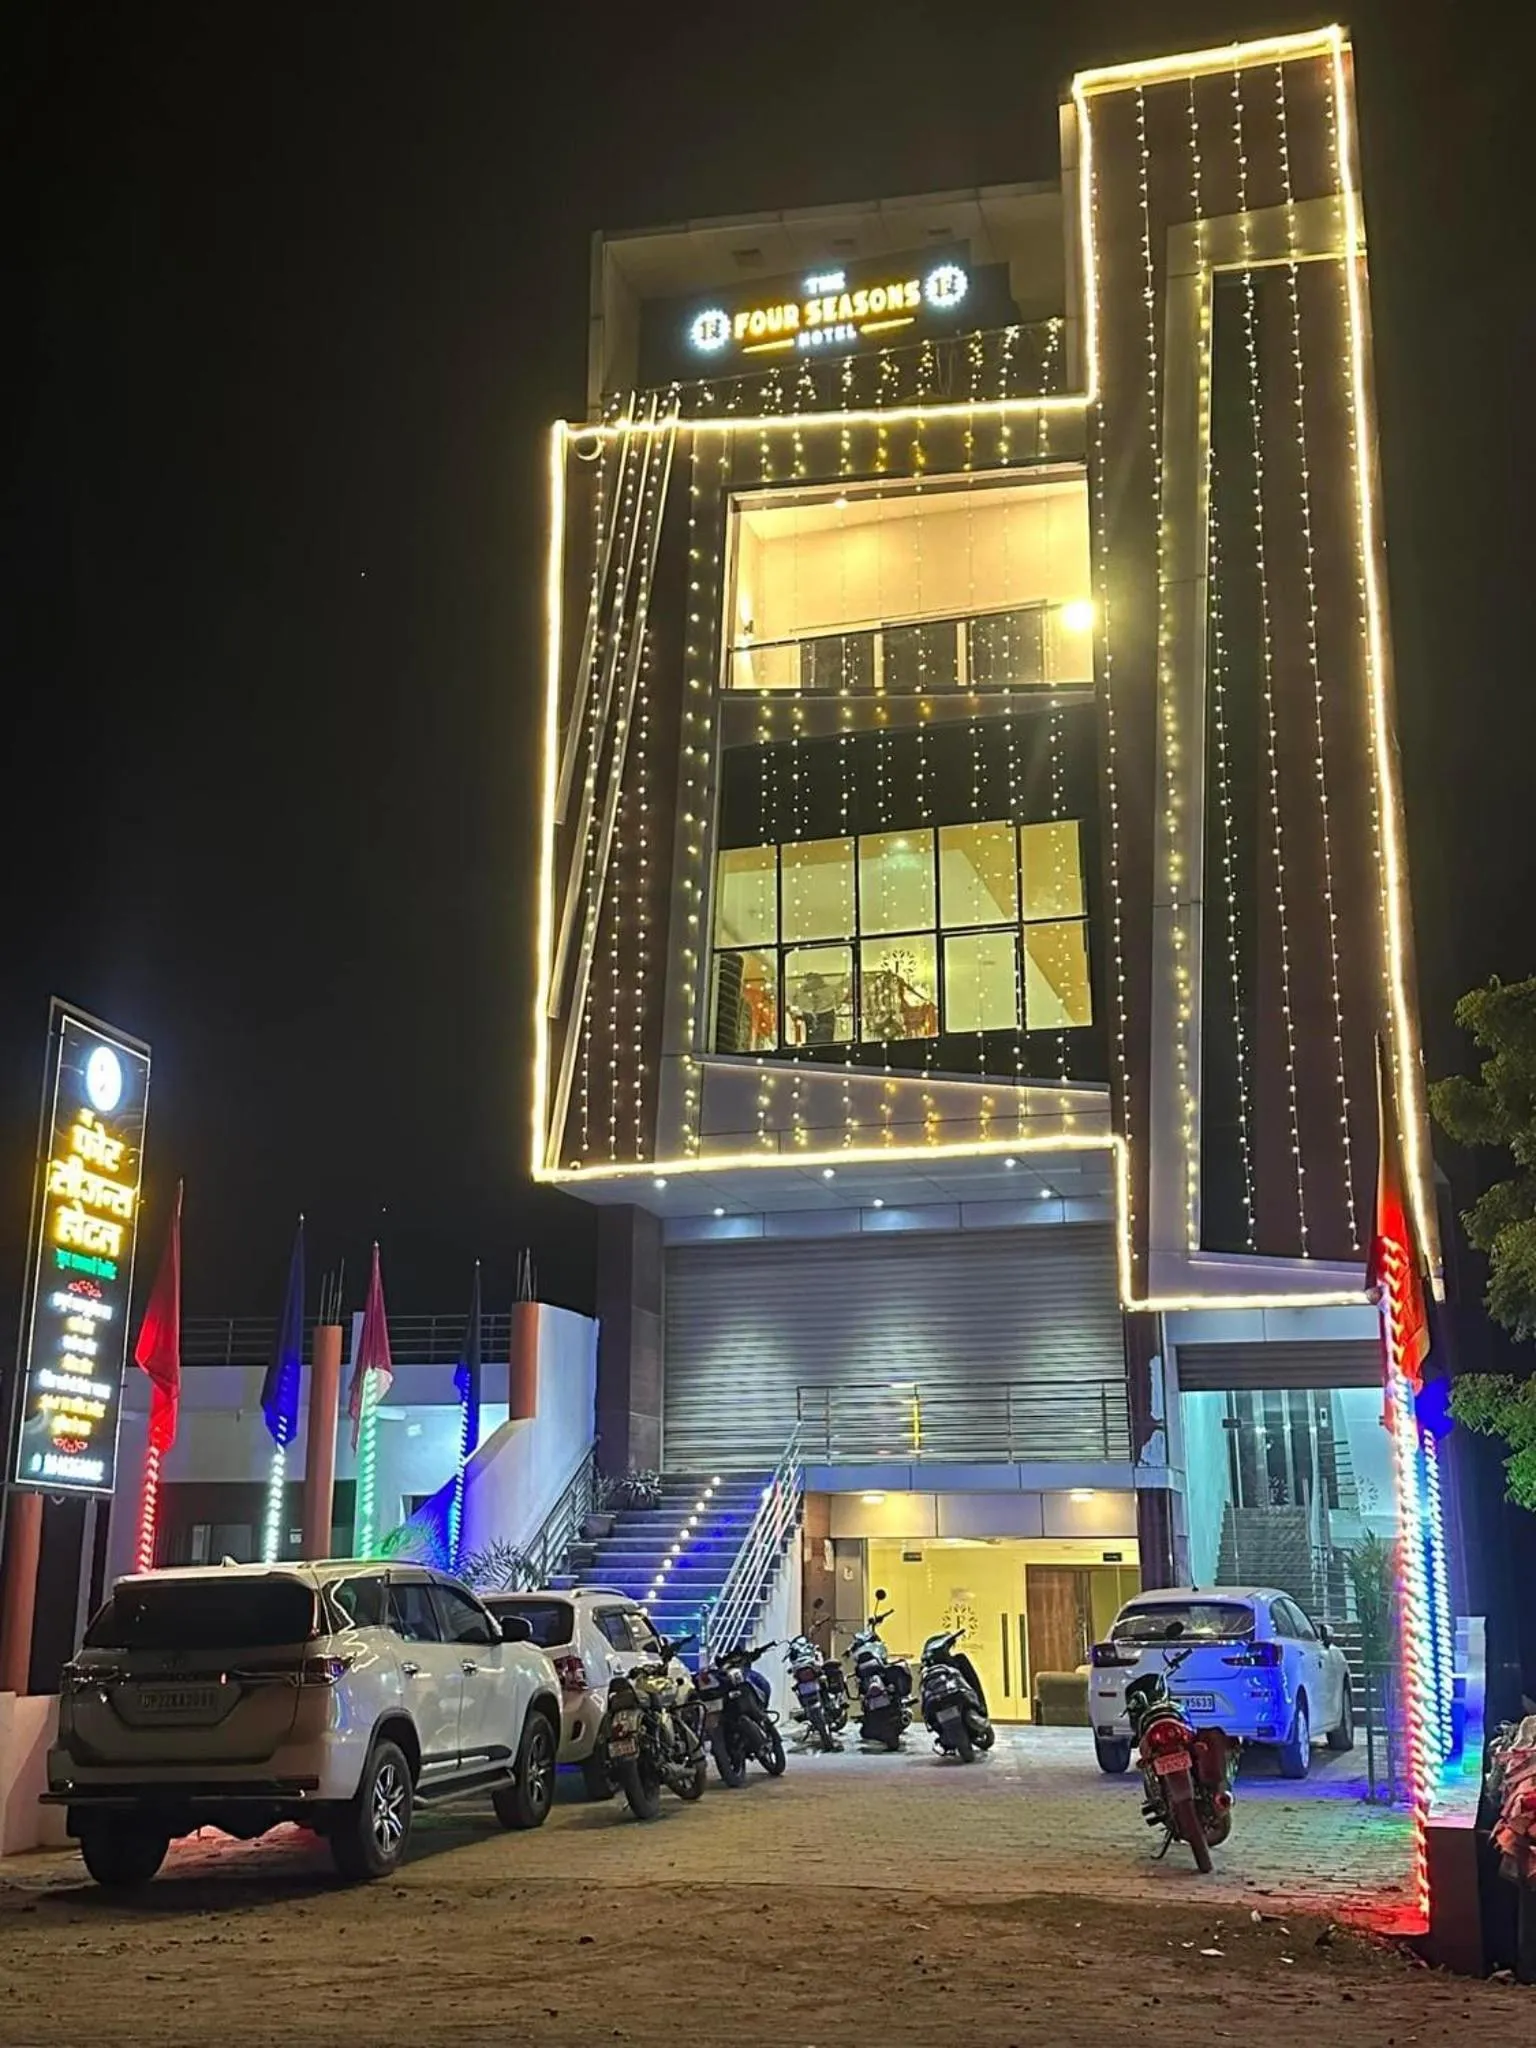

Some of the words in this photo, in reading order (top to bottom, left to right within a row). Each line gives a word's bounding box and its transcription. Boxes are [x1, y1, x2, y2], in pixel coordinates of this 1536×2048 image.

[804, 272, 846, 294] THE
[733, 304, 801, 339] FOUR
[804, 279, 922, 327] SEASONS
[797, 324, 858, 349] HOTEL
